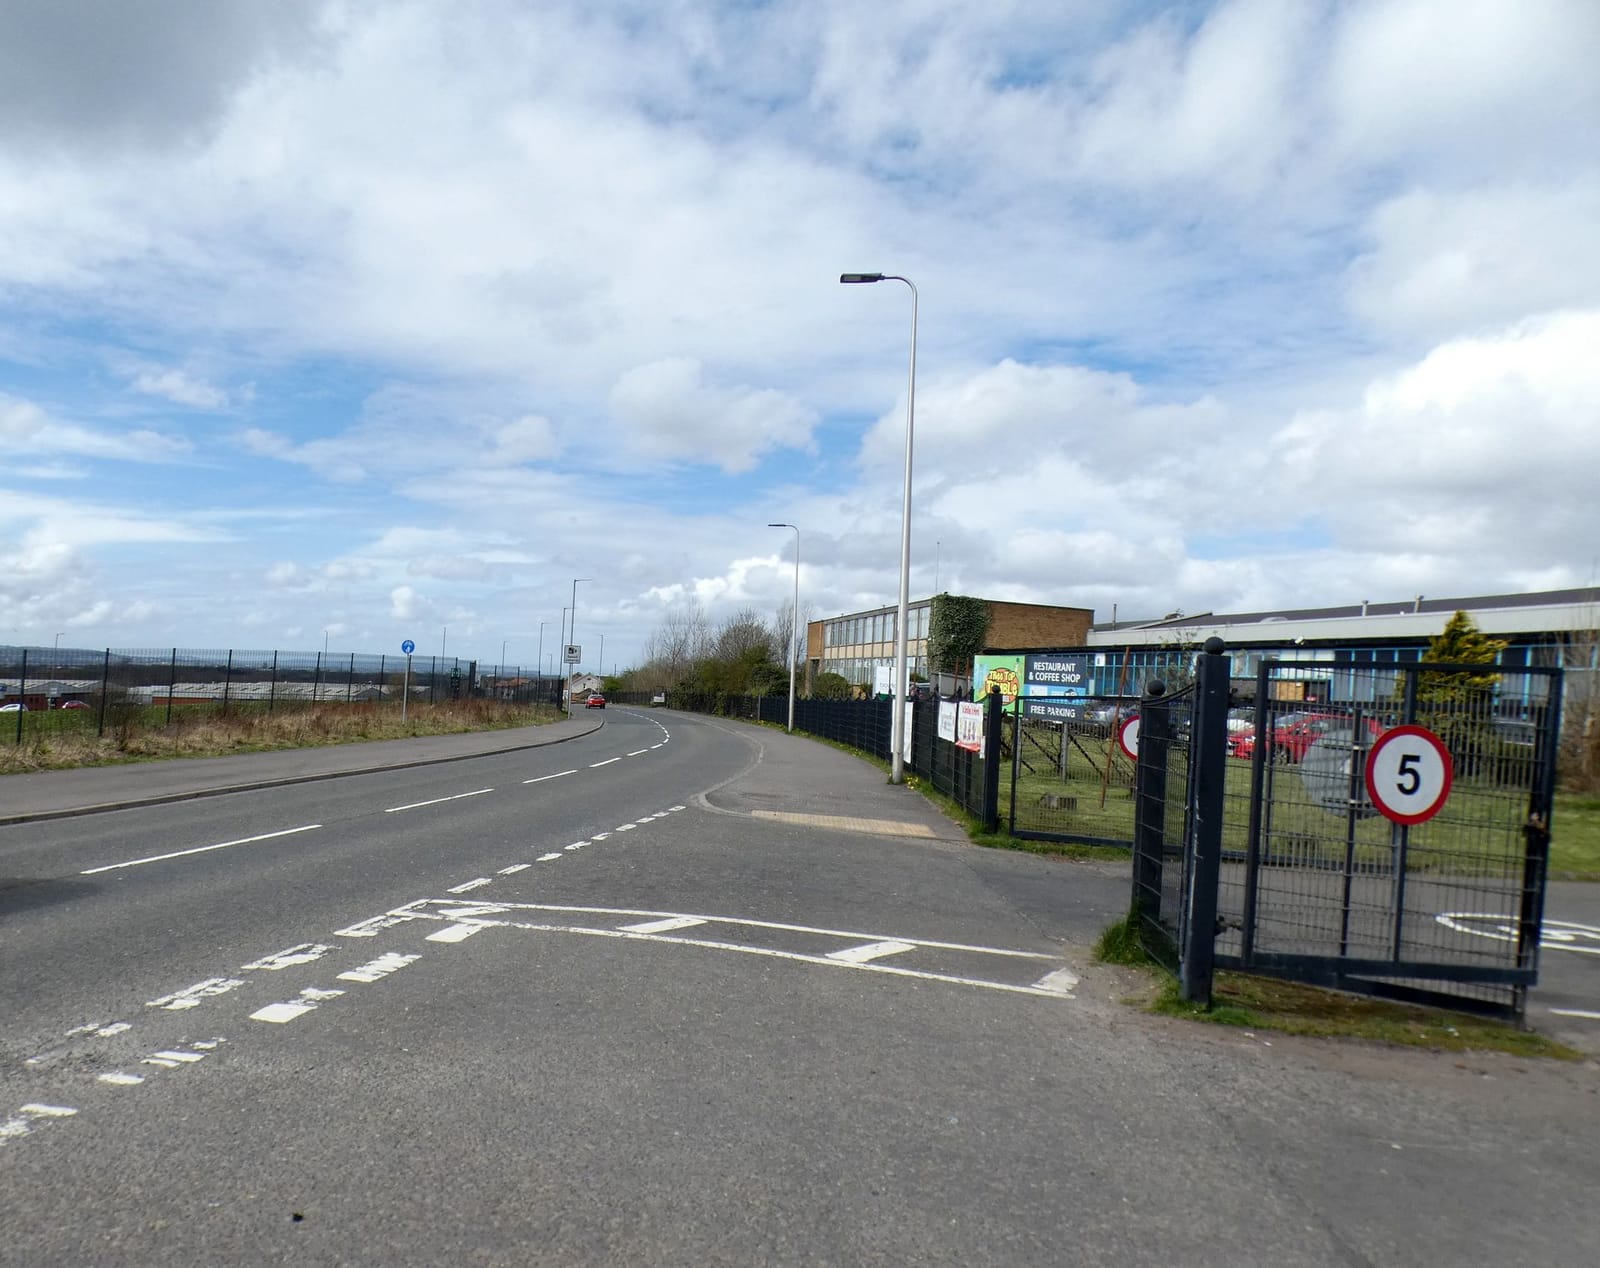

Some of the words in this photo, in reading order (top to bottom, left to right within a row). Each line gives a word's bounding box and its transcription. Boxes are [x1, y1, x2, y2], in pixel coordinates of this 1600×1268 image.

[1033, 662, 1076, 672] RESTAURANT
[1028, 672, 1034, 681] &
[1035, 672, 1060, 682] COFFEE
[1061, 673, 1081, 683] SHOP
[1030, 705, 1046, 715] FREE
[1047, 706, 1076, 718] PARKING
[1396, 754, 1421, 795] 5
